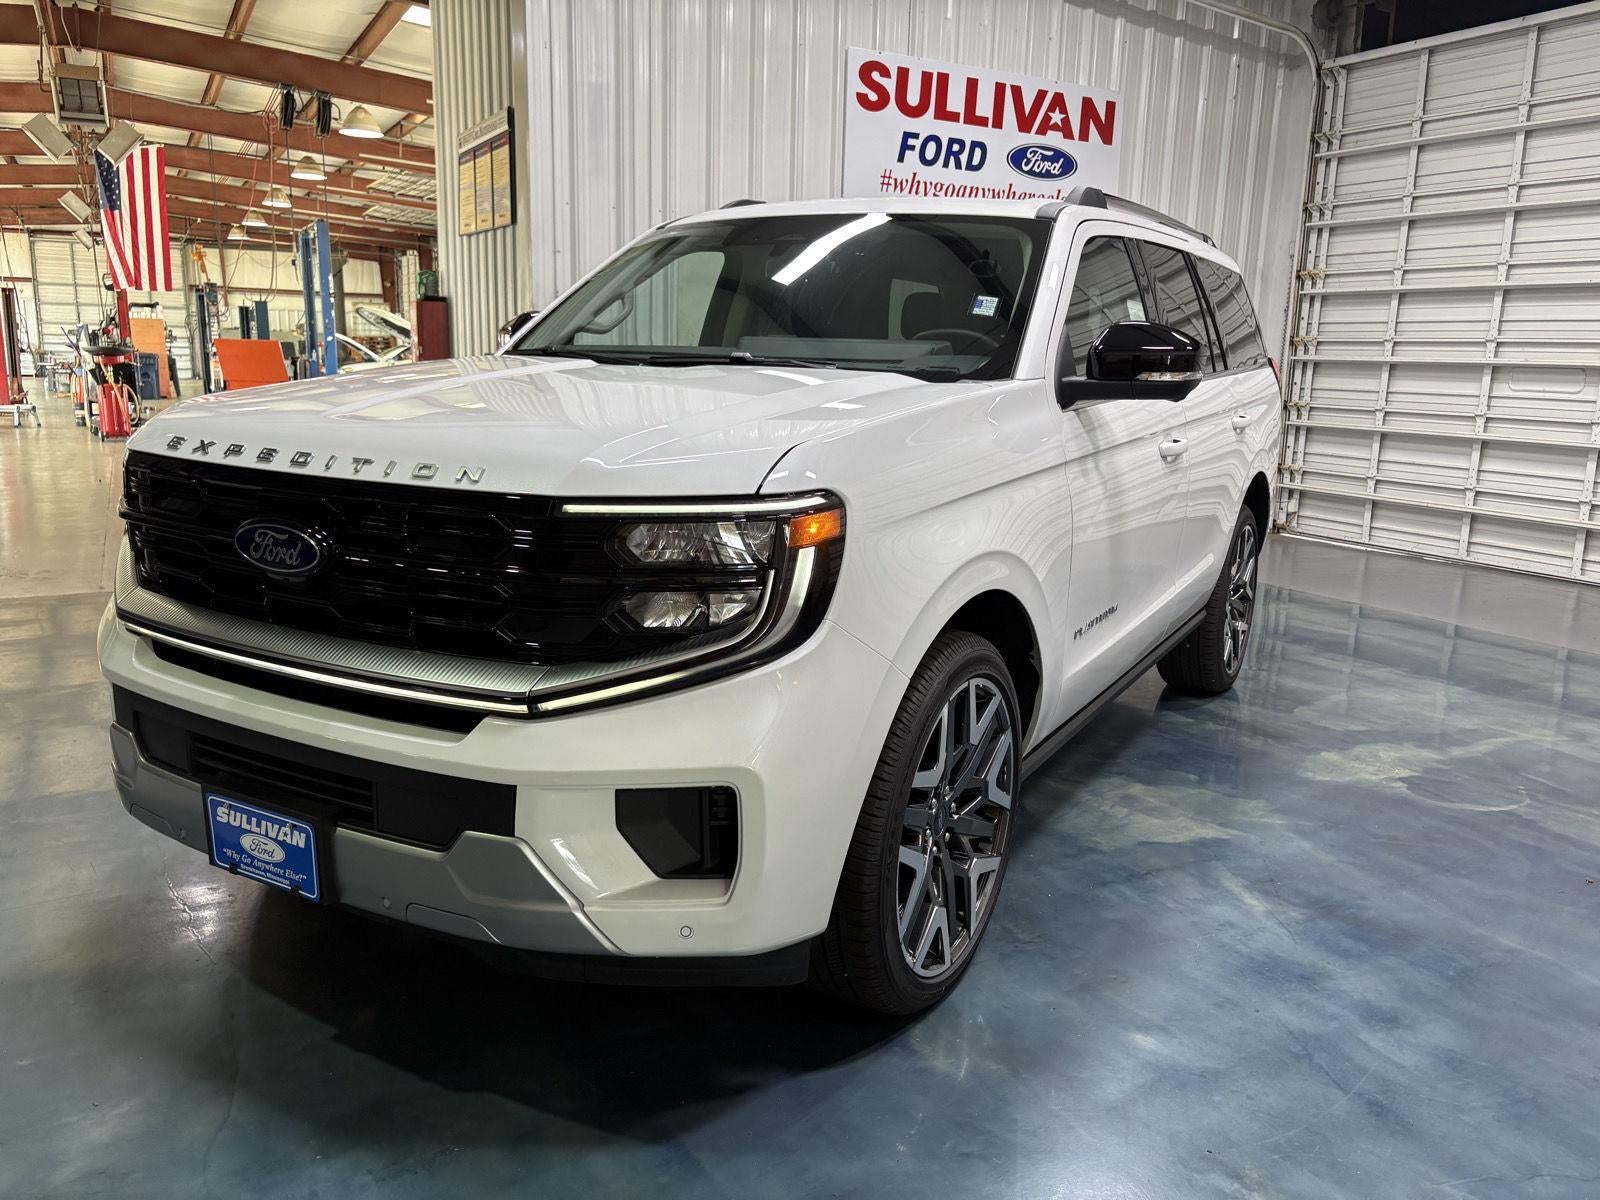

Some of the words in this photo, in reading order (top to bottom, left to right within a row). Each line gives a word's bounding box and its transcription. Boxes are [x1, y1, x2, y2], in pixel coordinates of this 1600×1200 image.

[856, 60, 1116, 146] SULLIVAN
[897, 131, 988, 172] FORD
[1021, 146, 1064, 176] Ford
[166, 435, 487, 484] EXPEDITION
[250, 528, 301, 566] Ford
[216, 806, 307, 849] SULLIVAN
[241, 854, 252, 864] Go
[252, 859, 284, 876] Anywhere
[249, 838, 276, 860] Ford
